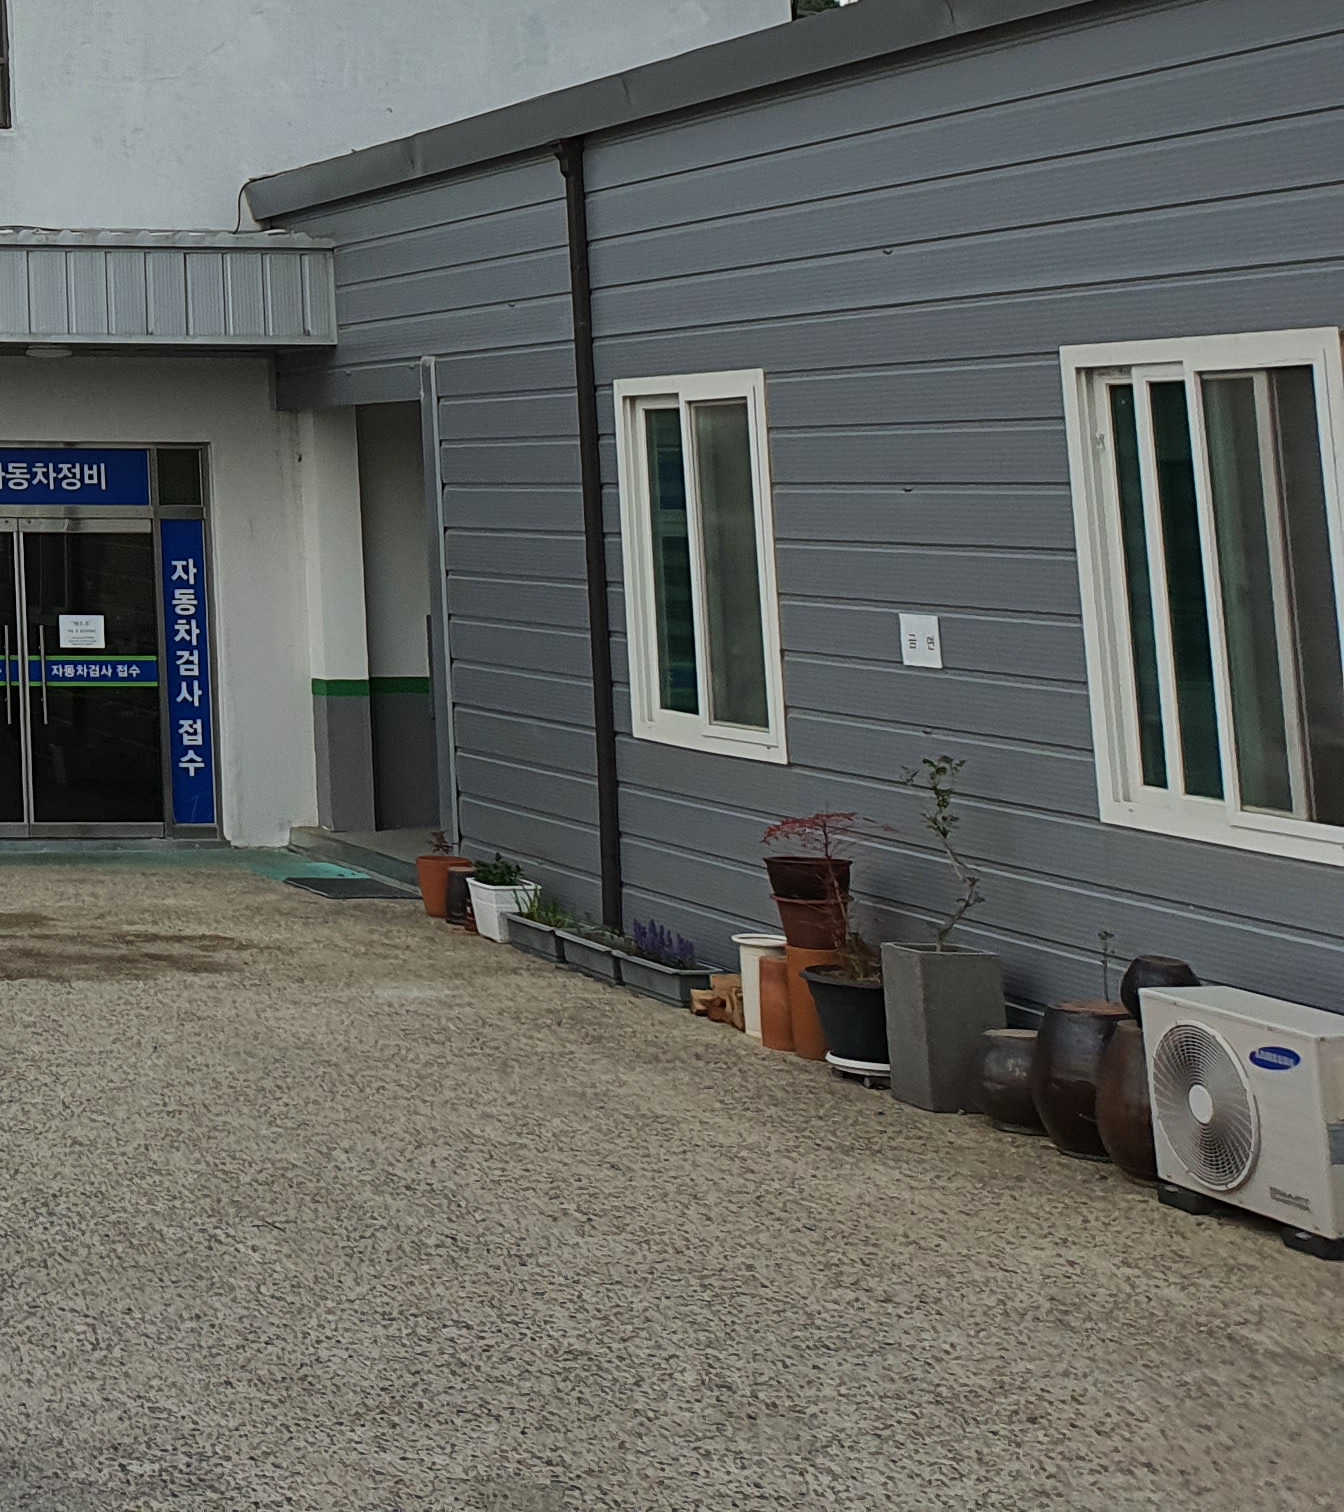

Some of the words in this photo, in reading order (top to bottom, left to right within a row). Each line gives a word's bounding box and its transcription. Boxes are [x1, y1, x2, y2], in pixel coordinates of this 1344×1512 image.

[170, 558, 203, 708] 자동차검사
[51, 663, 113, 679] 자동차검사
[116, 664, 142, 678] 접수
[177, 718, 206, 778] 접수
